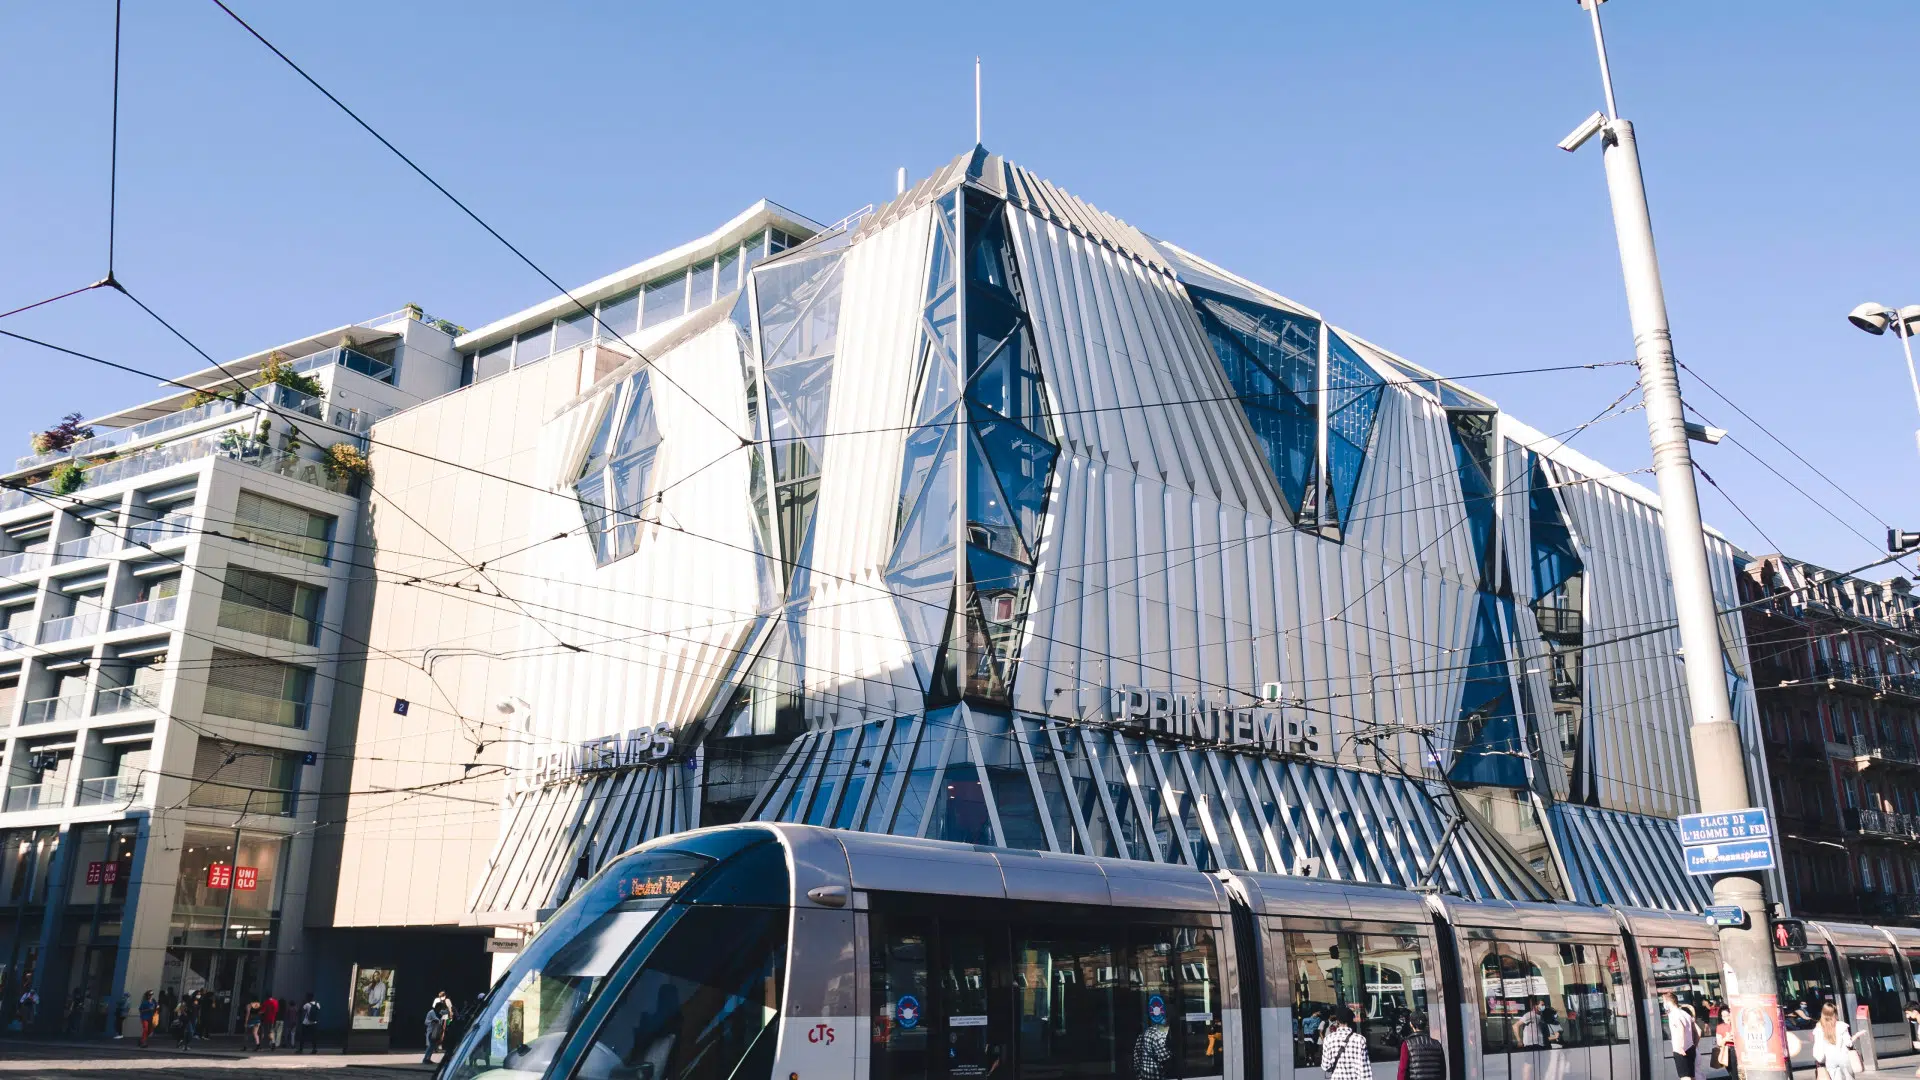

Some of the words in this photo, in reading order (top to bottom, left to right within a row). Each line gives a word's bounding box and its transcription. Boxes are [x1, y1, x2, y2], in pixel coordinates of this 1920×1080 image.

[398, 703, 405, 712] 2
[1121, 683, 1319, 756] PRINTEMPS
[534, 722, 674, 787] PRINTEMPS
[1700, 816, 1730, 827] PLACE
[1732, 815, 1746, 825] DE
[1683, 827, 1729, 841] L'HOMME
[1732, 826, 1746, 836] DE
[1749, 824, 1767, 834] FER
[105, 863, 118, 872] UNI
[238, 869, 256, 879] UNI
[237, 878, 255, 889] QLO
